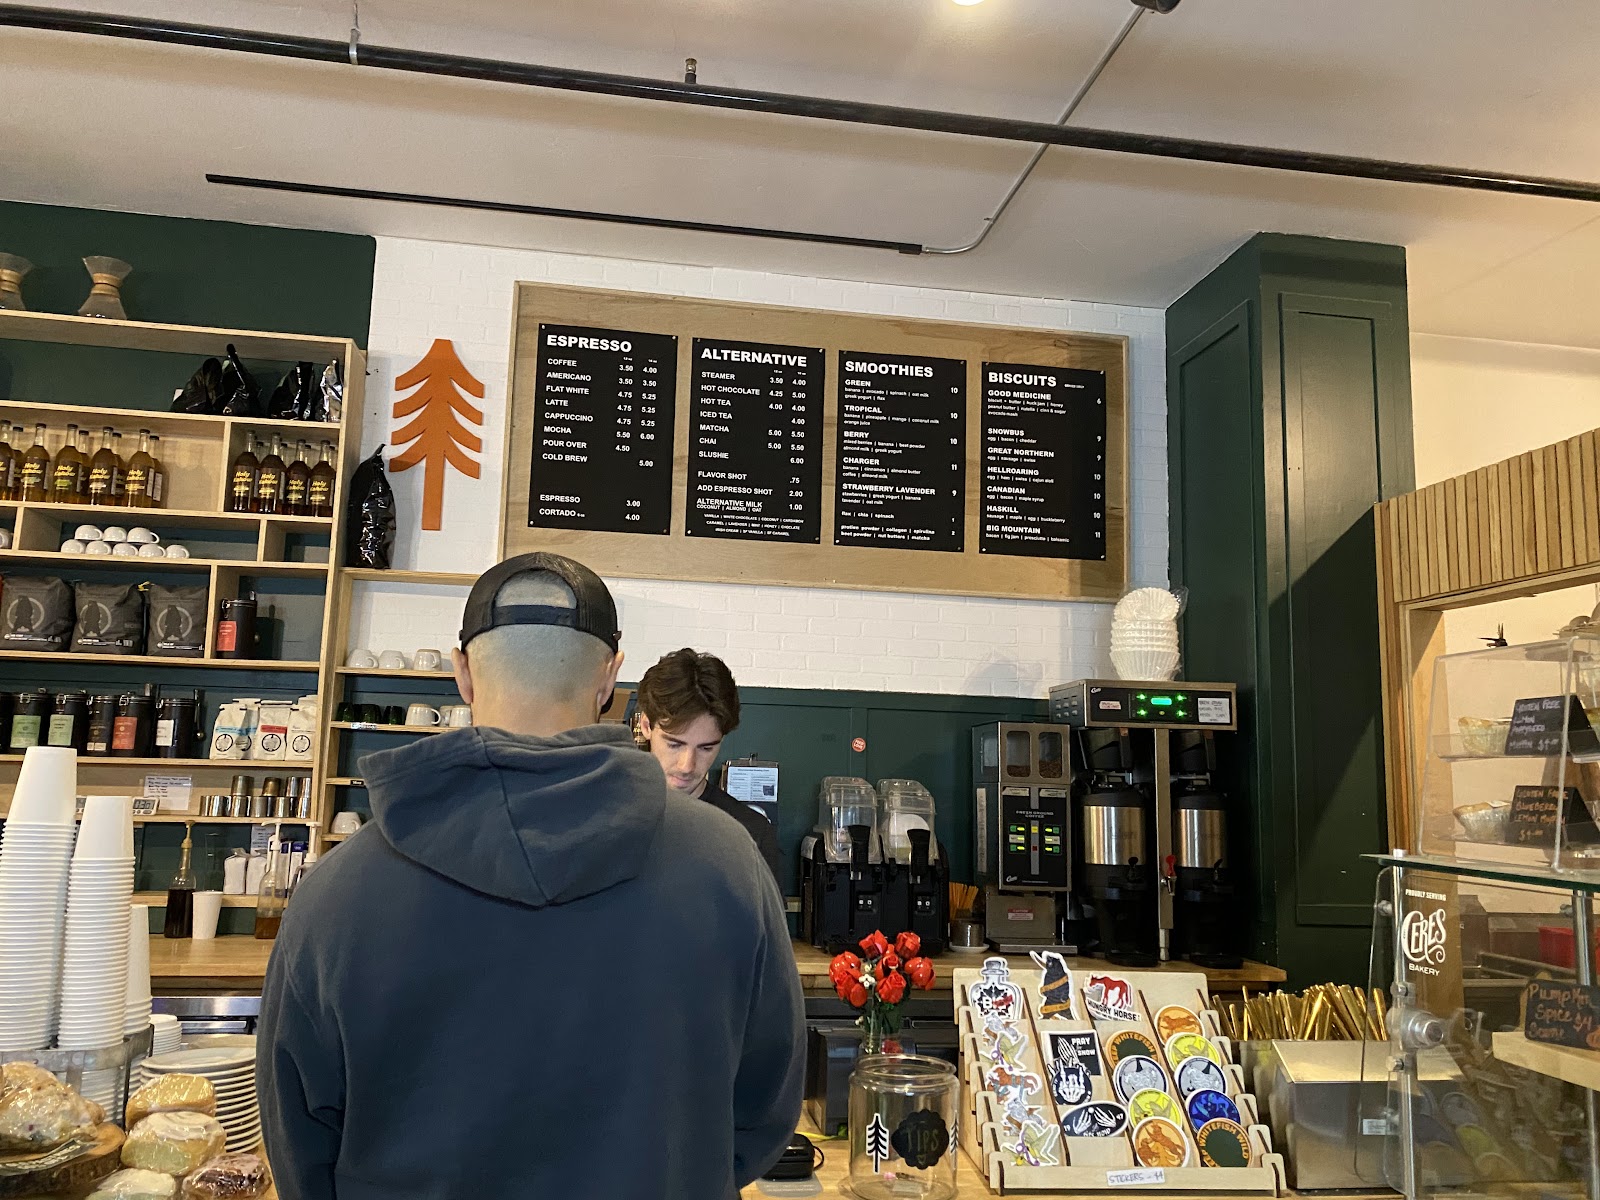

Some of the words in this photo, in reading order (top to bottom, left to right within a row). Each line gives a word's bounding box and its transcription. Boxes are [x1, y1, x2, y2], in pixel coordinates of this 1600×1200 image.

[546, 334, 631, 352] ESPRESSO
[547, 358, 577, 366] COFFEE
[700, 348, 806, 367] ALTERNATIVE
[844, 360, 933, 377] SMOOTHIES
[546, 371, 591, 381] AMERICANO
[701, 371, 735, 380] STEAMER
[988, 371, 1056, 386] BISCUITS
[717, 385, 760, 395] CHOCOLATE
[1012, 391, 1051, 400] MEDICINE
[844, 404, 882, 413] TROPICAL
[544, 412, 593, 422] CAPPUCCINO
[543, 425, 571, 433] MOCHA
[699, 423, 729, 432] MATCHA
[987, 427, 1024, 436] SNOWBUS
[698, 450, 728, 458] SLUSHIE
[1013, 448, 1054, 457] NORTHERN
[842, 456, 879, 465] CHARGER
[987, 466, 1039, 475] HELLROARING
[714, 485, 752, 494] ESPRESSO
[842, 482, 894, 492] STRAWBERRY
[895, 486, 935, 495] LAVENDER
[986, 485, 1025, 494] CANADIAN
[539, 494, 580, 503] ESPRESSO
[697, 498, 744, 507] ALTERNATIVE
[538, 508, 576, 516] CORTADO
[986, 505, 1018, 513] HASKILL
[1001, 525, 1040, 534] MOUNTAIN
[1406, 889, 1425, 898] PROUDLY
[1426, 892, 1446, 901] SERVING
[1401, 908, 1446, 965] CERES
[1409, 963, 1440, 976] BAKERY
[1114, 1009, 1137, 1021] HORSE
[1113, 1032, 1155, 1052] WHITEFISH
[1200, 1122, 1236, 1146] WHITEFISH
[1237, 1133, 1249, 1159] WILD
[1109, 1172, 1144, 1183] STICKERS
